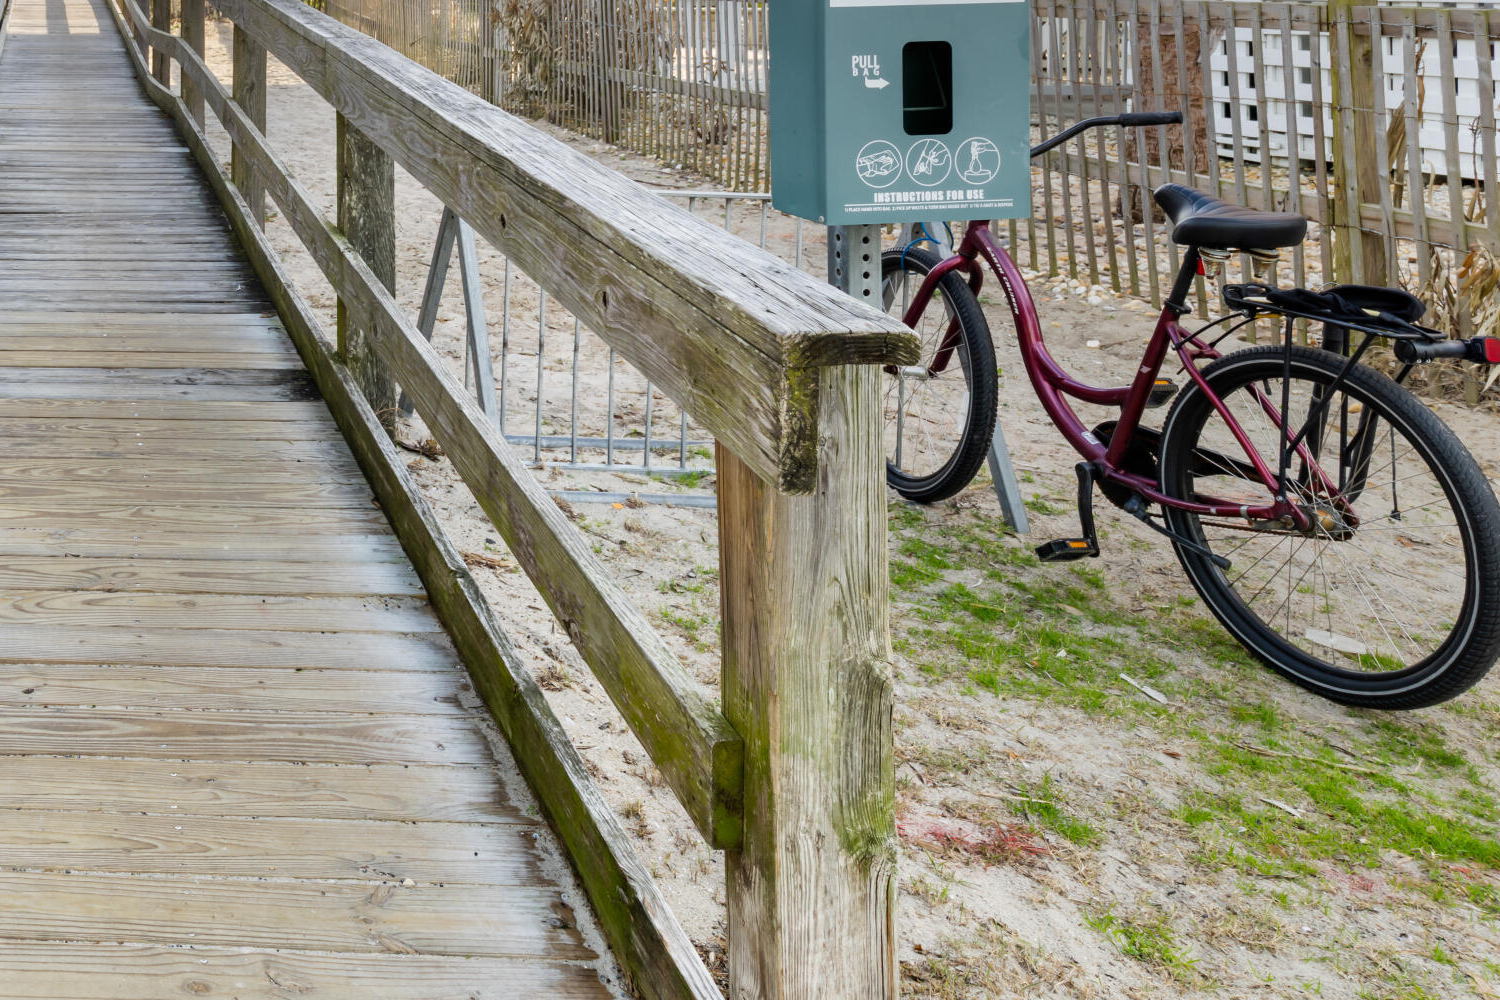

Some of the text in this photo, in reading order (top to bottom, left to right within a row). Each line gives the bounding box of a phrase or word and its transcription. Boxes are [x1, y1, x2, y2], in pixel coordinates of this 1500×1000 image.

[852, 55, 880, 69] PULL
[874, 190, 984, 202] INSTRUCTIONS FOR USE
